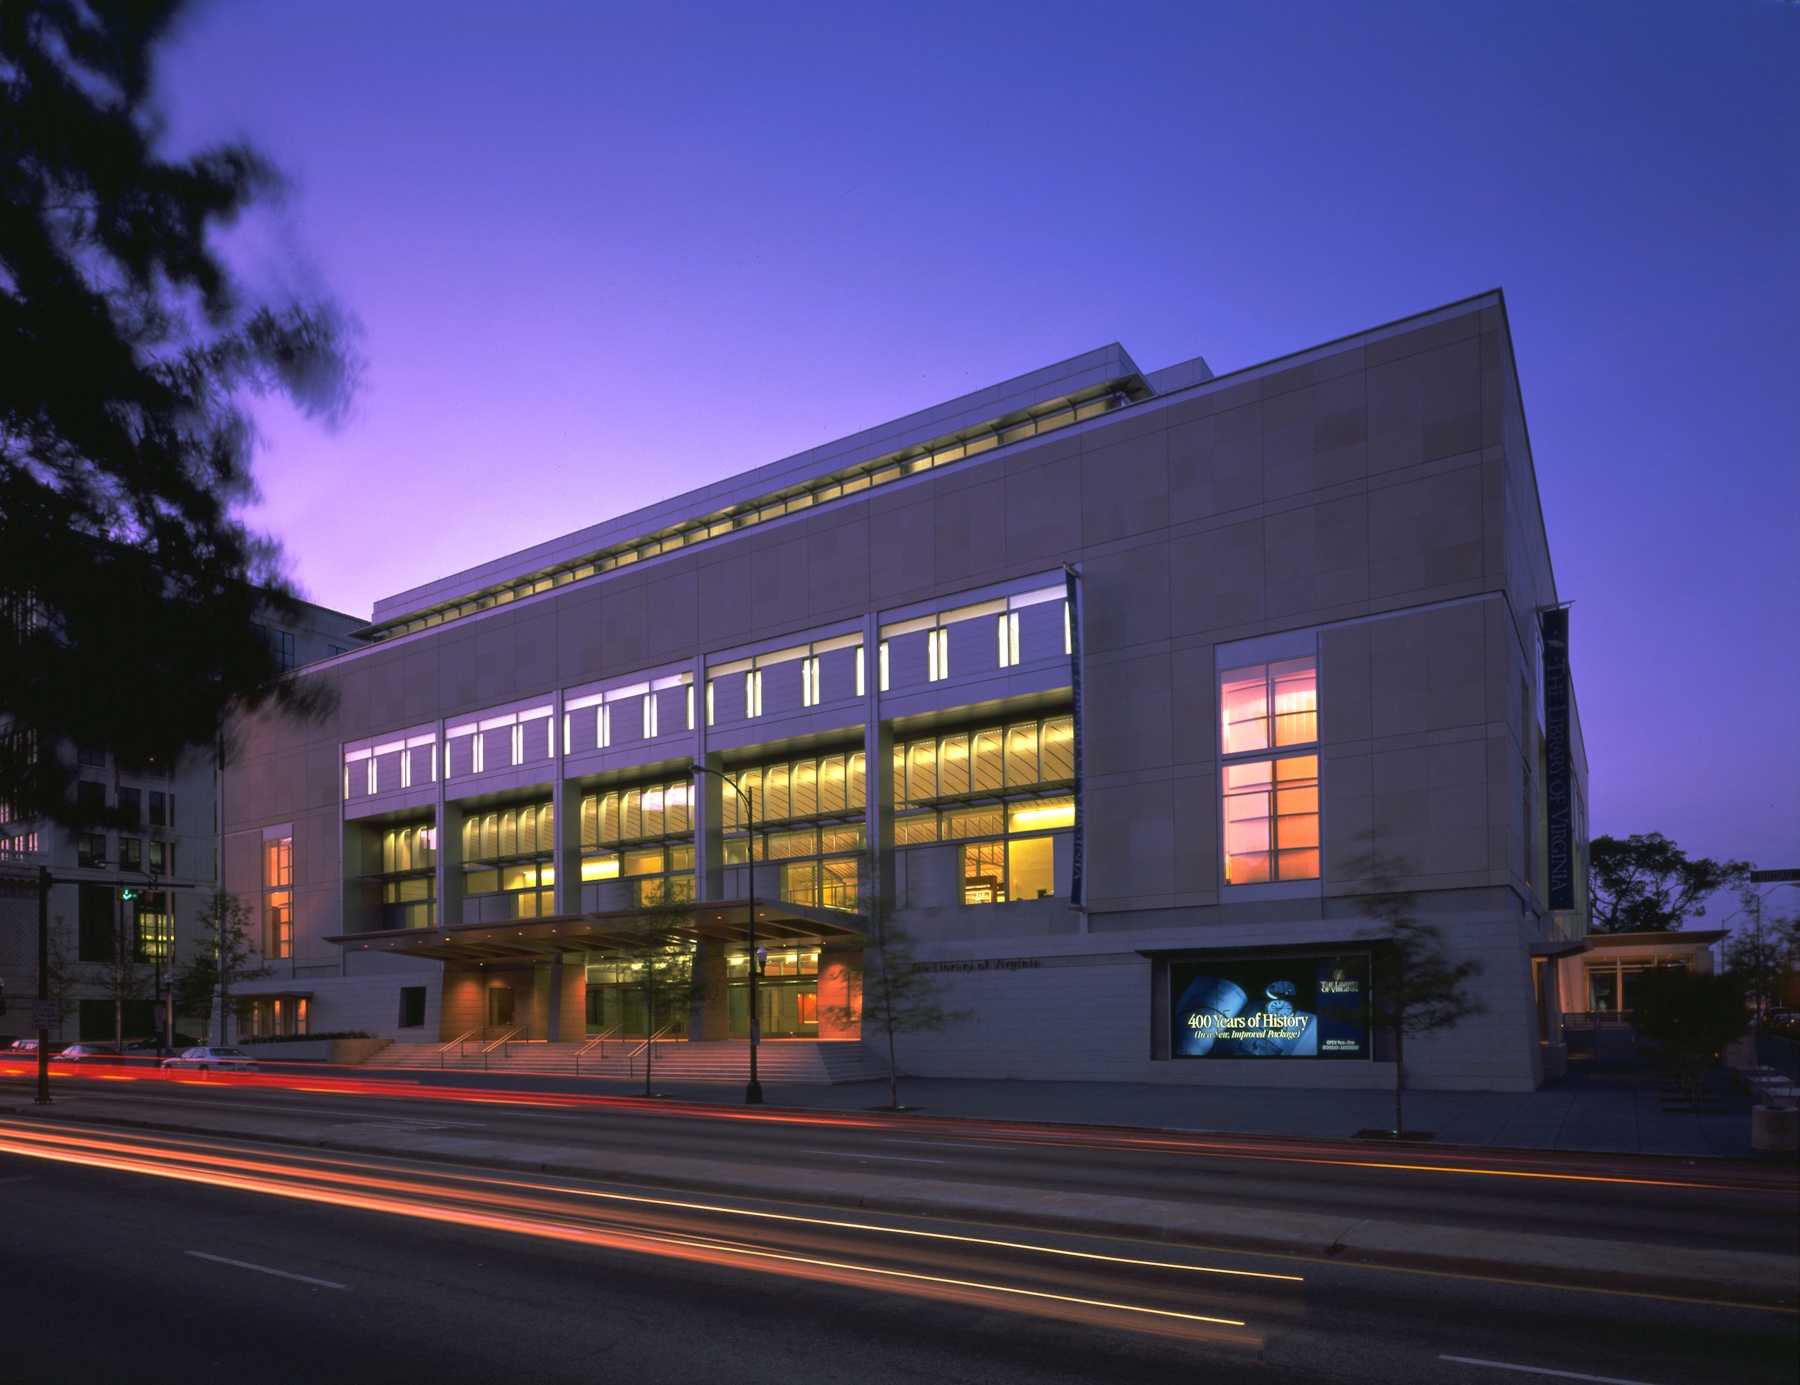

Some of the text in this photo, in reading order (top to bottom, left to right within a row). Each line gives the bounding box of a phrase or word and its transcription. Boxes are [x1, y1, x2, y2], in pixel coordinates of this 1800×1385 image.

[1547, 661, 1569, 892] THE LIBRARY OF VIRGINIA
[1759, 870, 1793, 880] BROAD
[933, 961, 974, 973] Library
[977, 960, 988, 970] of
[994, 959, 1040, 972] Virginia
[1188, 1012, 1309, 1031] 400 Years of History
[1194, 1031, 1206, 1039] (In
[1213, 1031, 1230, 1039] New,
[1231, 1030, 1266, 1040] Improved
[1267, 1030, 1301, 1040] Package)
